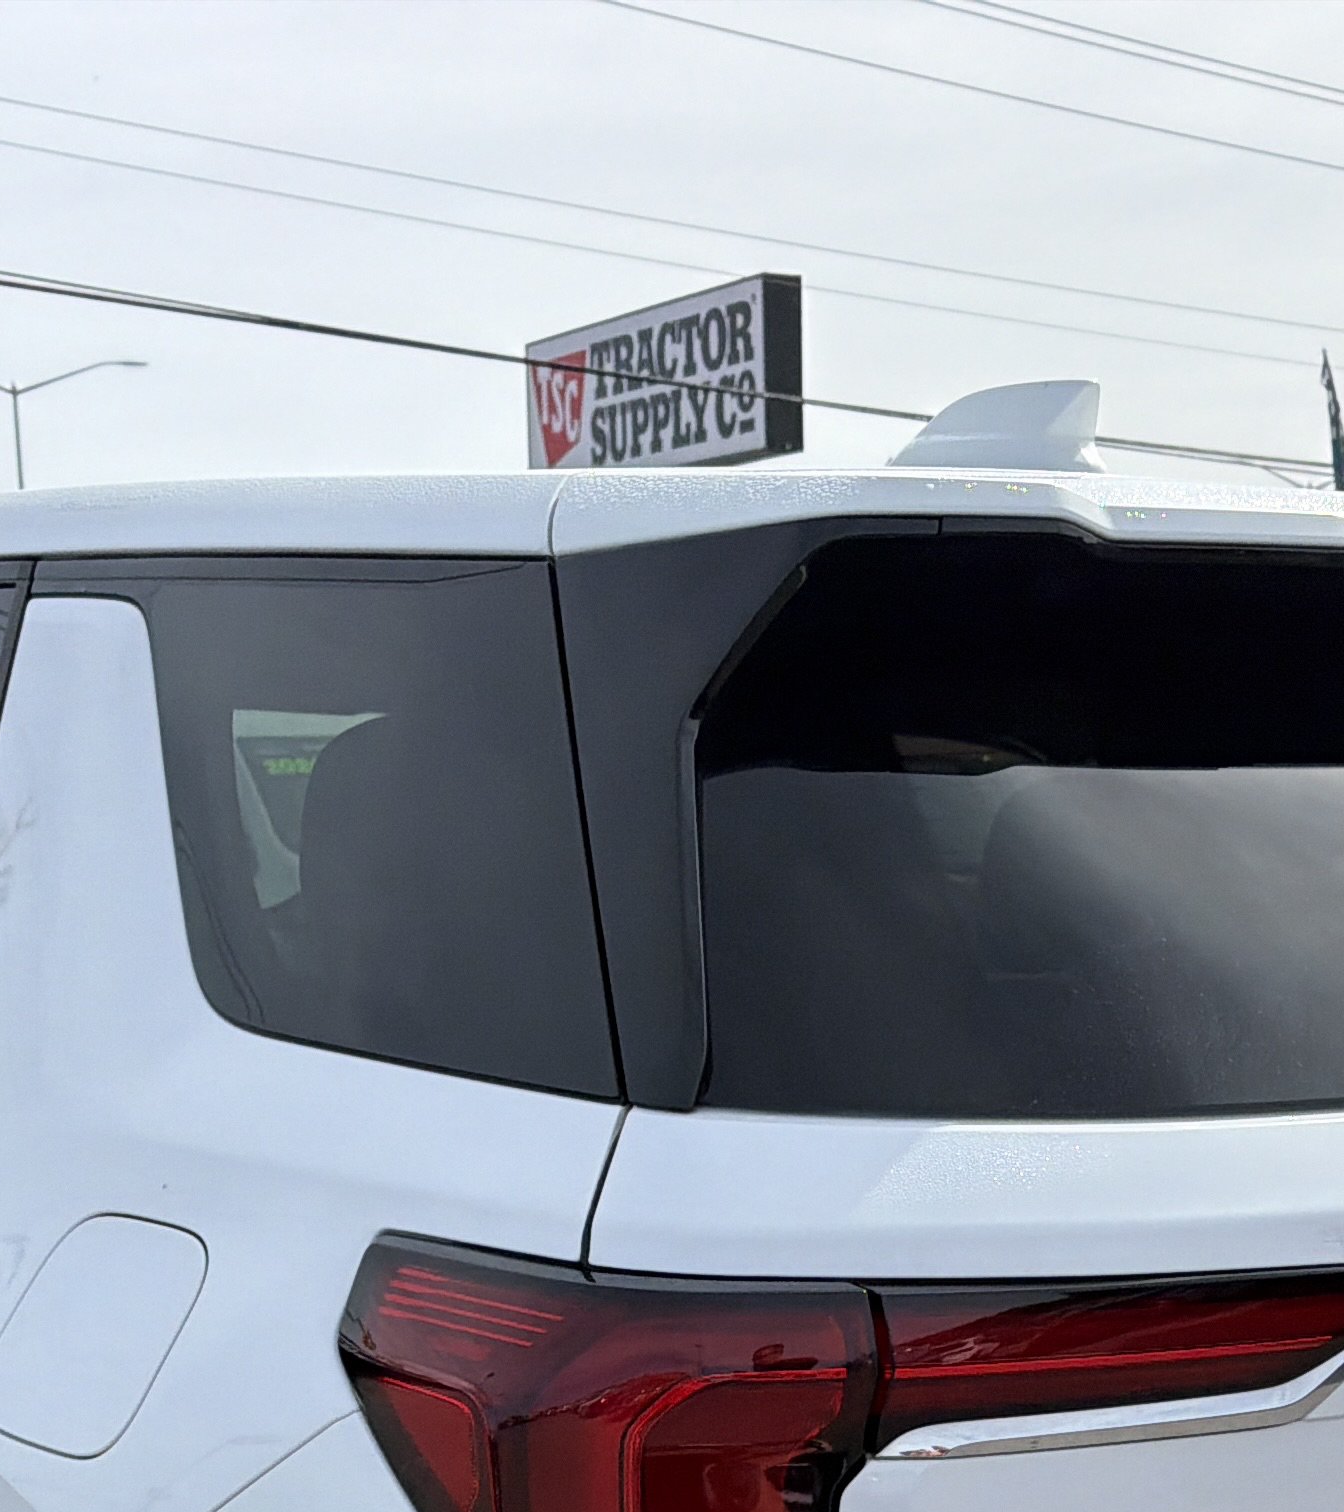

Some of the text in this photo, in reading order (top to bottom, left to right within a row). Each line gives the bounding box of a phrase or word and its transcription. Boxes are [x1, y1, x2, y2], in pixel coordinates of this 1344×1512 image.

[589, 300, 755, 401] TRACTOR
[536, 364, 578, 443] TSC
[590, 379, 709, 466] SUPPLY
